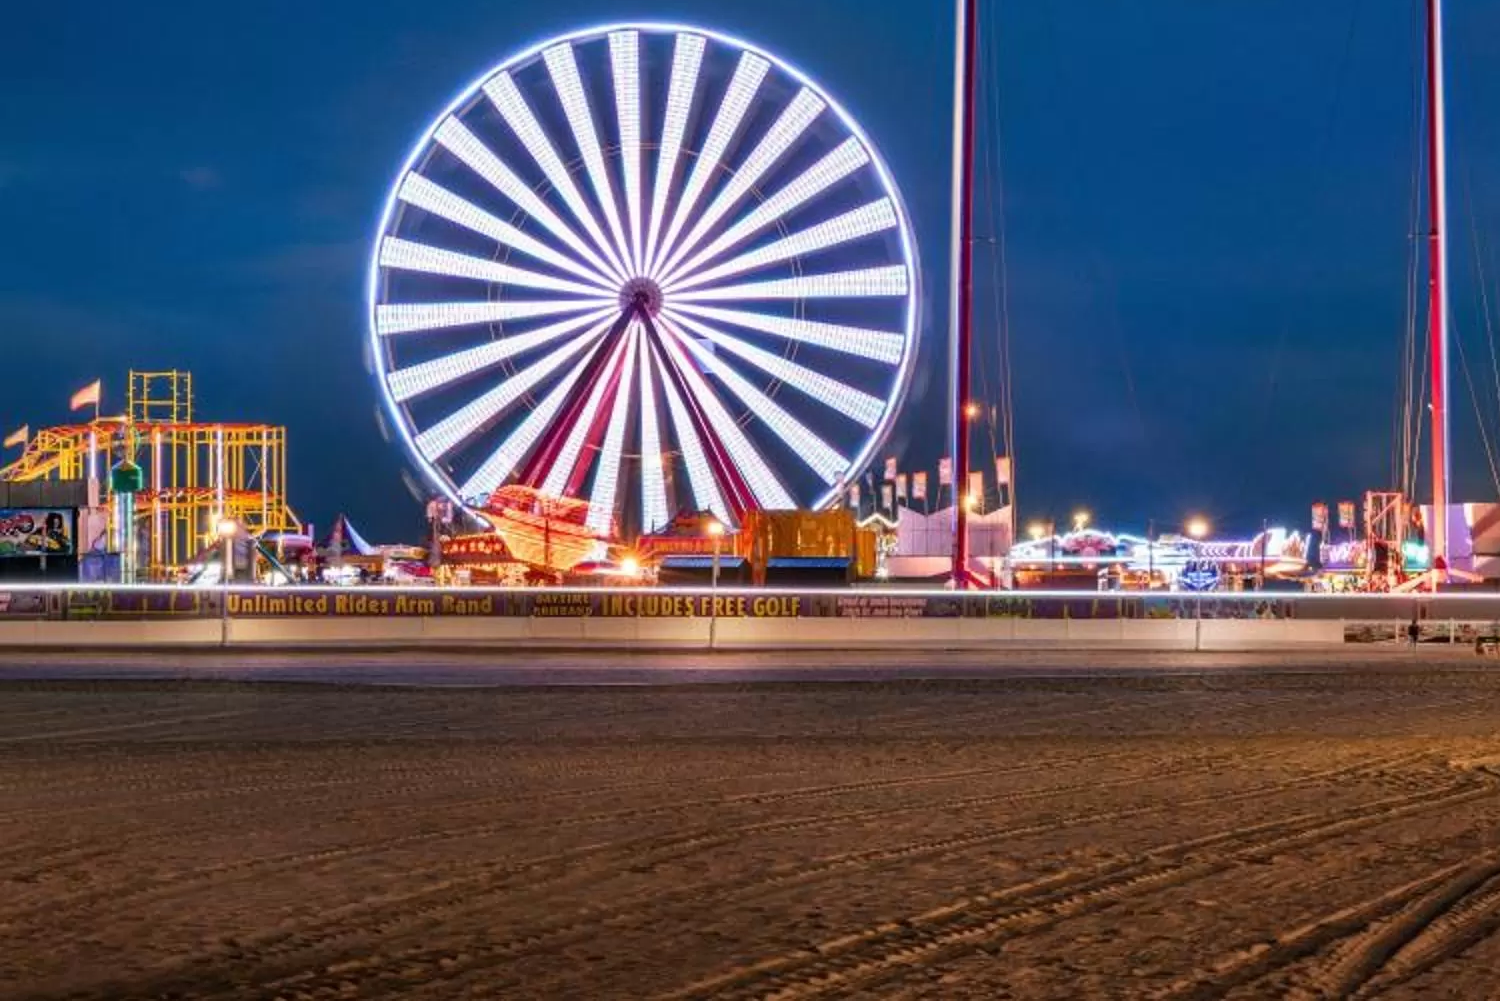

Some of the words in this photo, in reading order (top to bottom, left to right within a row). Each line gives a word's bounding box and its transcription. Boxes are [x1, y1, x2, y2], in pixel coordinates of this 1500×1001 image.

[227, 594, 328, 614] Unlimited
[334, 594, 388, 614] Rides
[395, 594, 435, 614] Arm
[440, 595, 492, 614] Band
[603, 596, 694, 616] INCLUDES
[701, 597, 746, 616] FREE
[753, 597, 801, 616] GOLF
